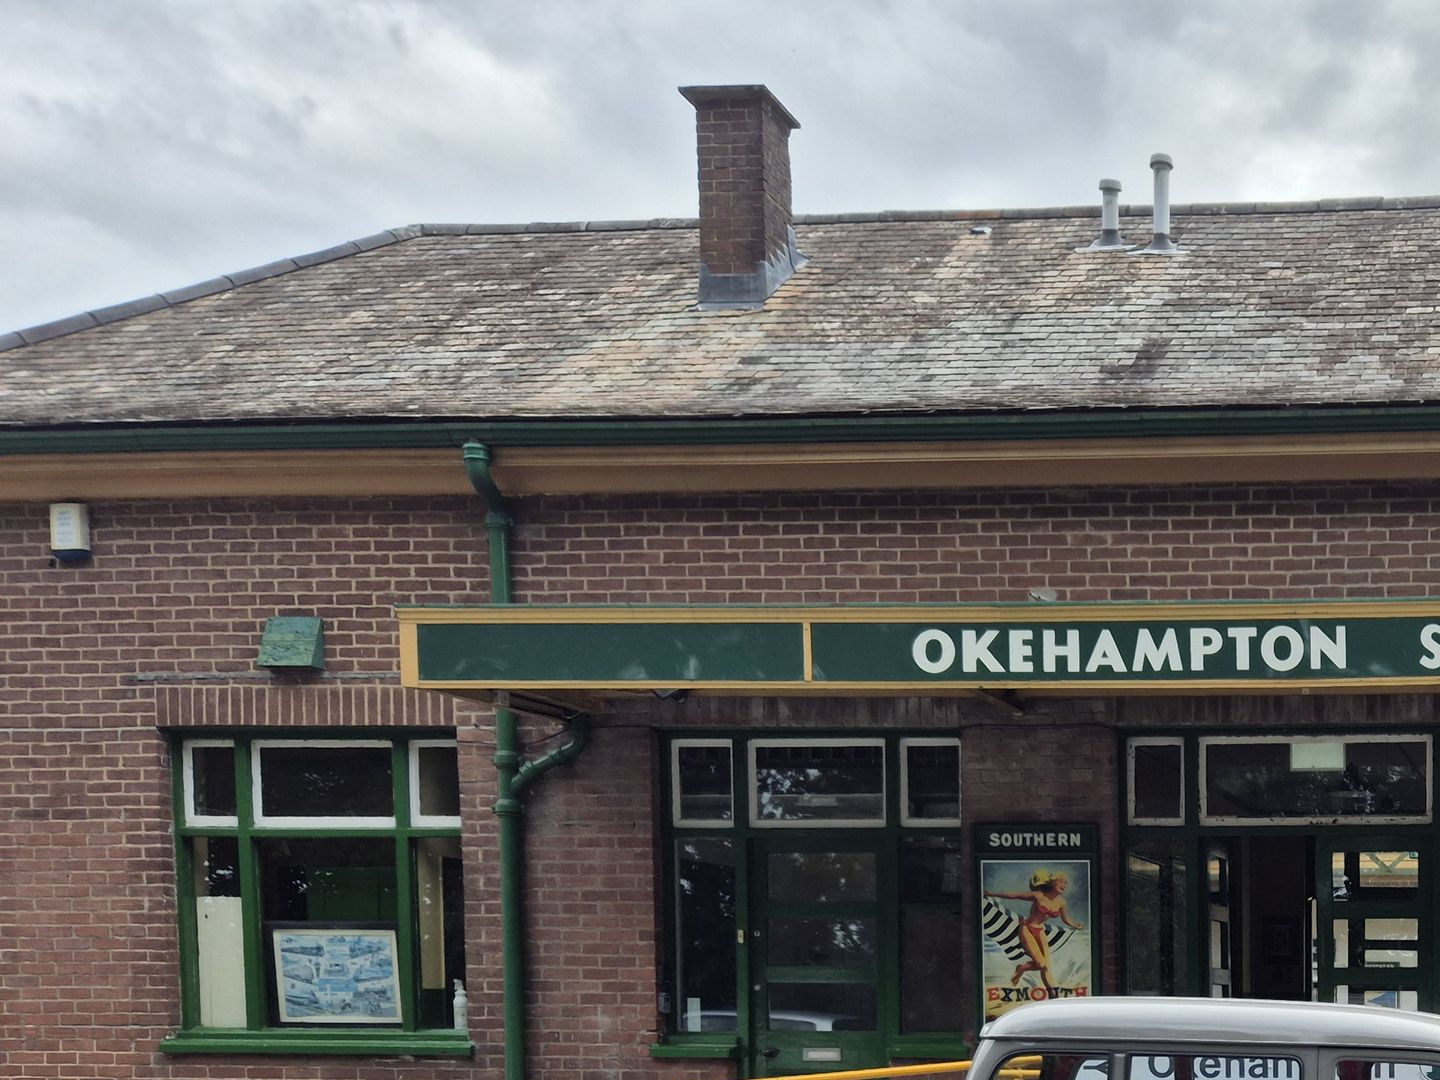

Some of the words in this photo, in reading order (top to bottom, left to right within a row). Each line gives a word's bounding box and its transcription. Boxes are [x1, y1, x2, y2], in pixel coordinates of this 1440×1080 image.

[911, 626, 1347, 674] OKEHAMPTON
[989, 833, 1081, 847] SOUTHERN
[987, 987, 1088, 1002] EXMOUTH
